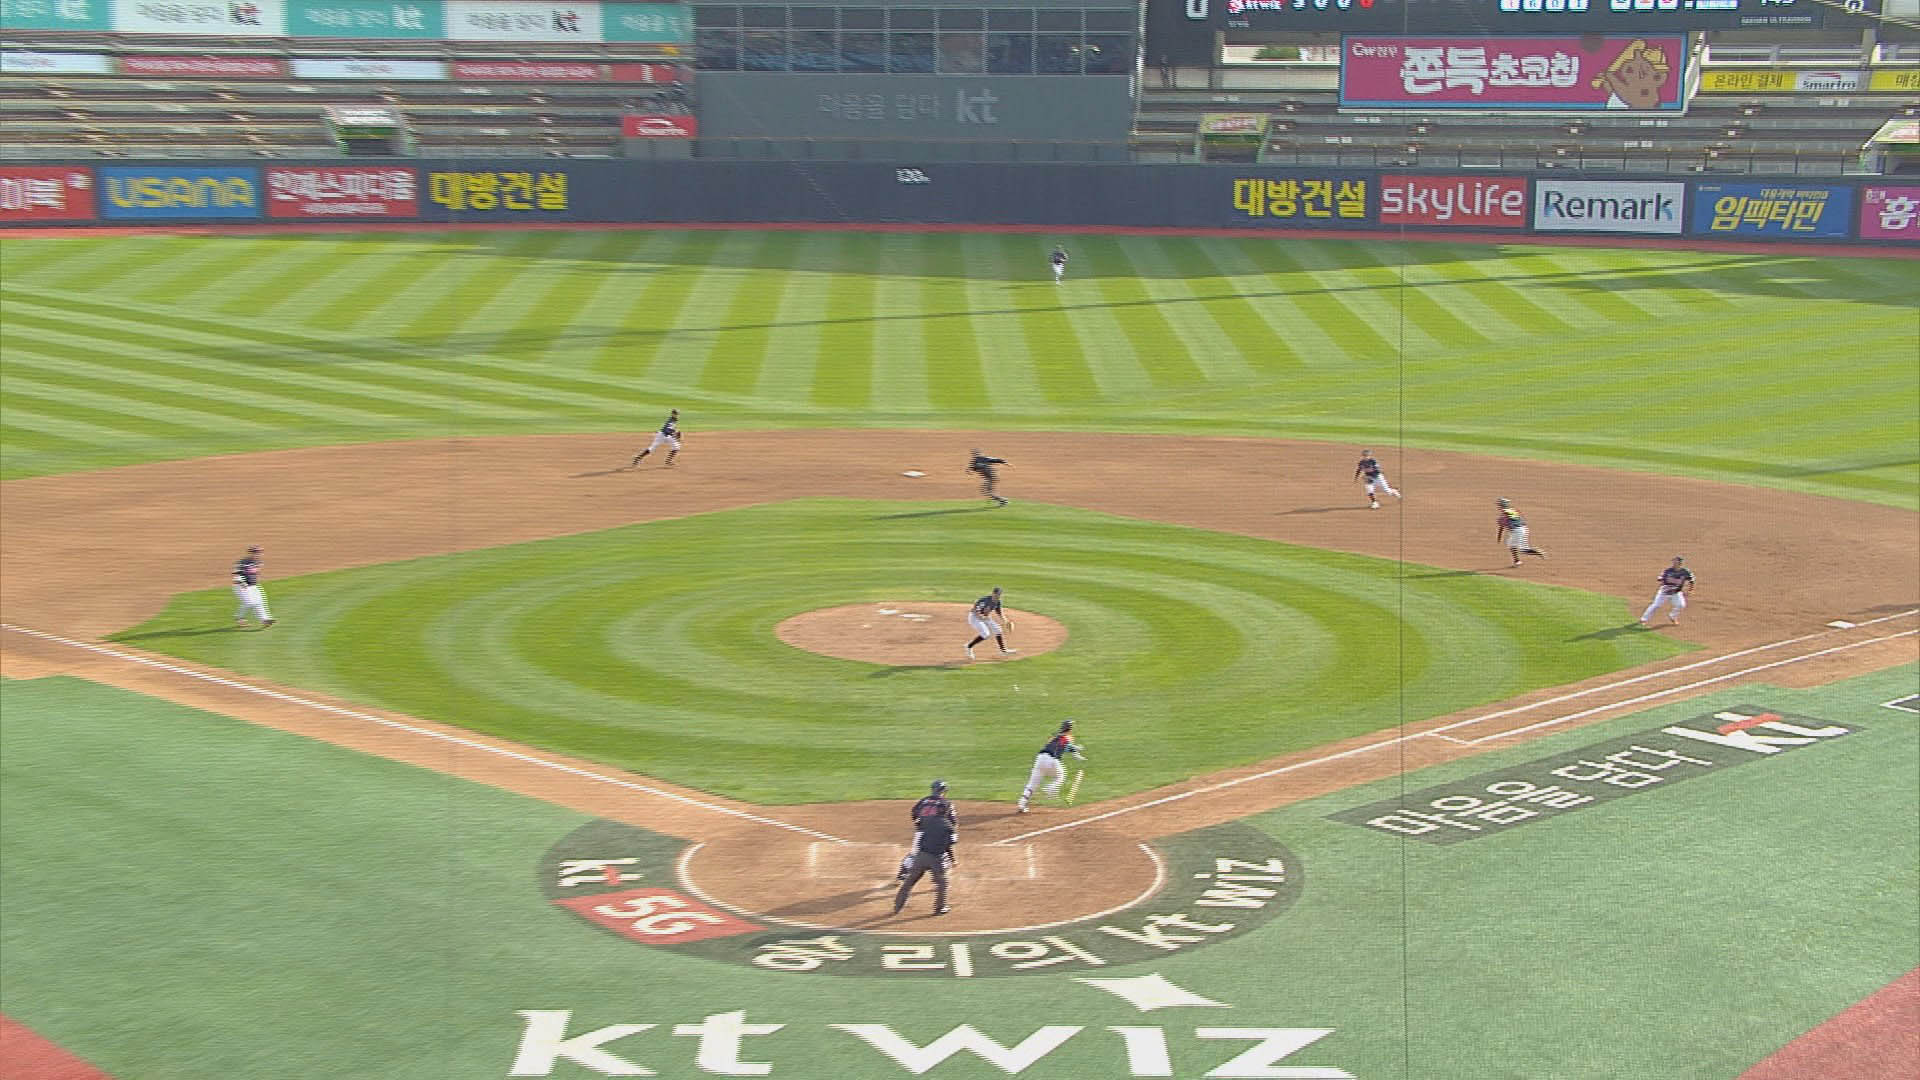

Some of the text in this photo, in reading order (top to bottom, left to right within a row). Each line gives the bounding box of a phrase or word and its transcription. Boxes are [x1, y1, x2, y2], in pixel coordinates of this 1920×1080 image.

[228, 1, 263, 26] kt
[392, 5, 425, 30] kt
[551, 10, 580, 33] kt
[1714, 73, 1783, 88] 온라인 결제
[1802, 79, 1857, 91] Smartro
[956, 88, 1001, 125] kt
[105, 177, 256, 209] USANA
[267, 170, 417, 201] 인제스피디움
[428, 172, 569, 210] 대방건설
[1232, 178, 1367, 218] 대방건설
[1380, 182, 1524, 220] skylife
[1543, 189, 1674, 222] Remark
[1711, 194, 1826, 232] 임팩타민
[1366, 711, 1850, 834] 마음을 담다 kt
[594, 895, 725, 935] 5G
[1097, 912, 1236, 951] kt
[1193, 857, 1285, 909] wiz
[506, 972, 1358, 1080] kt wiz
